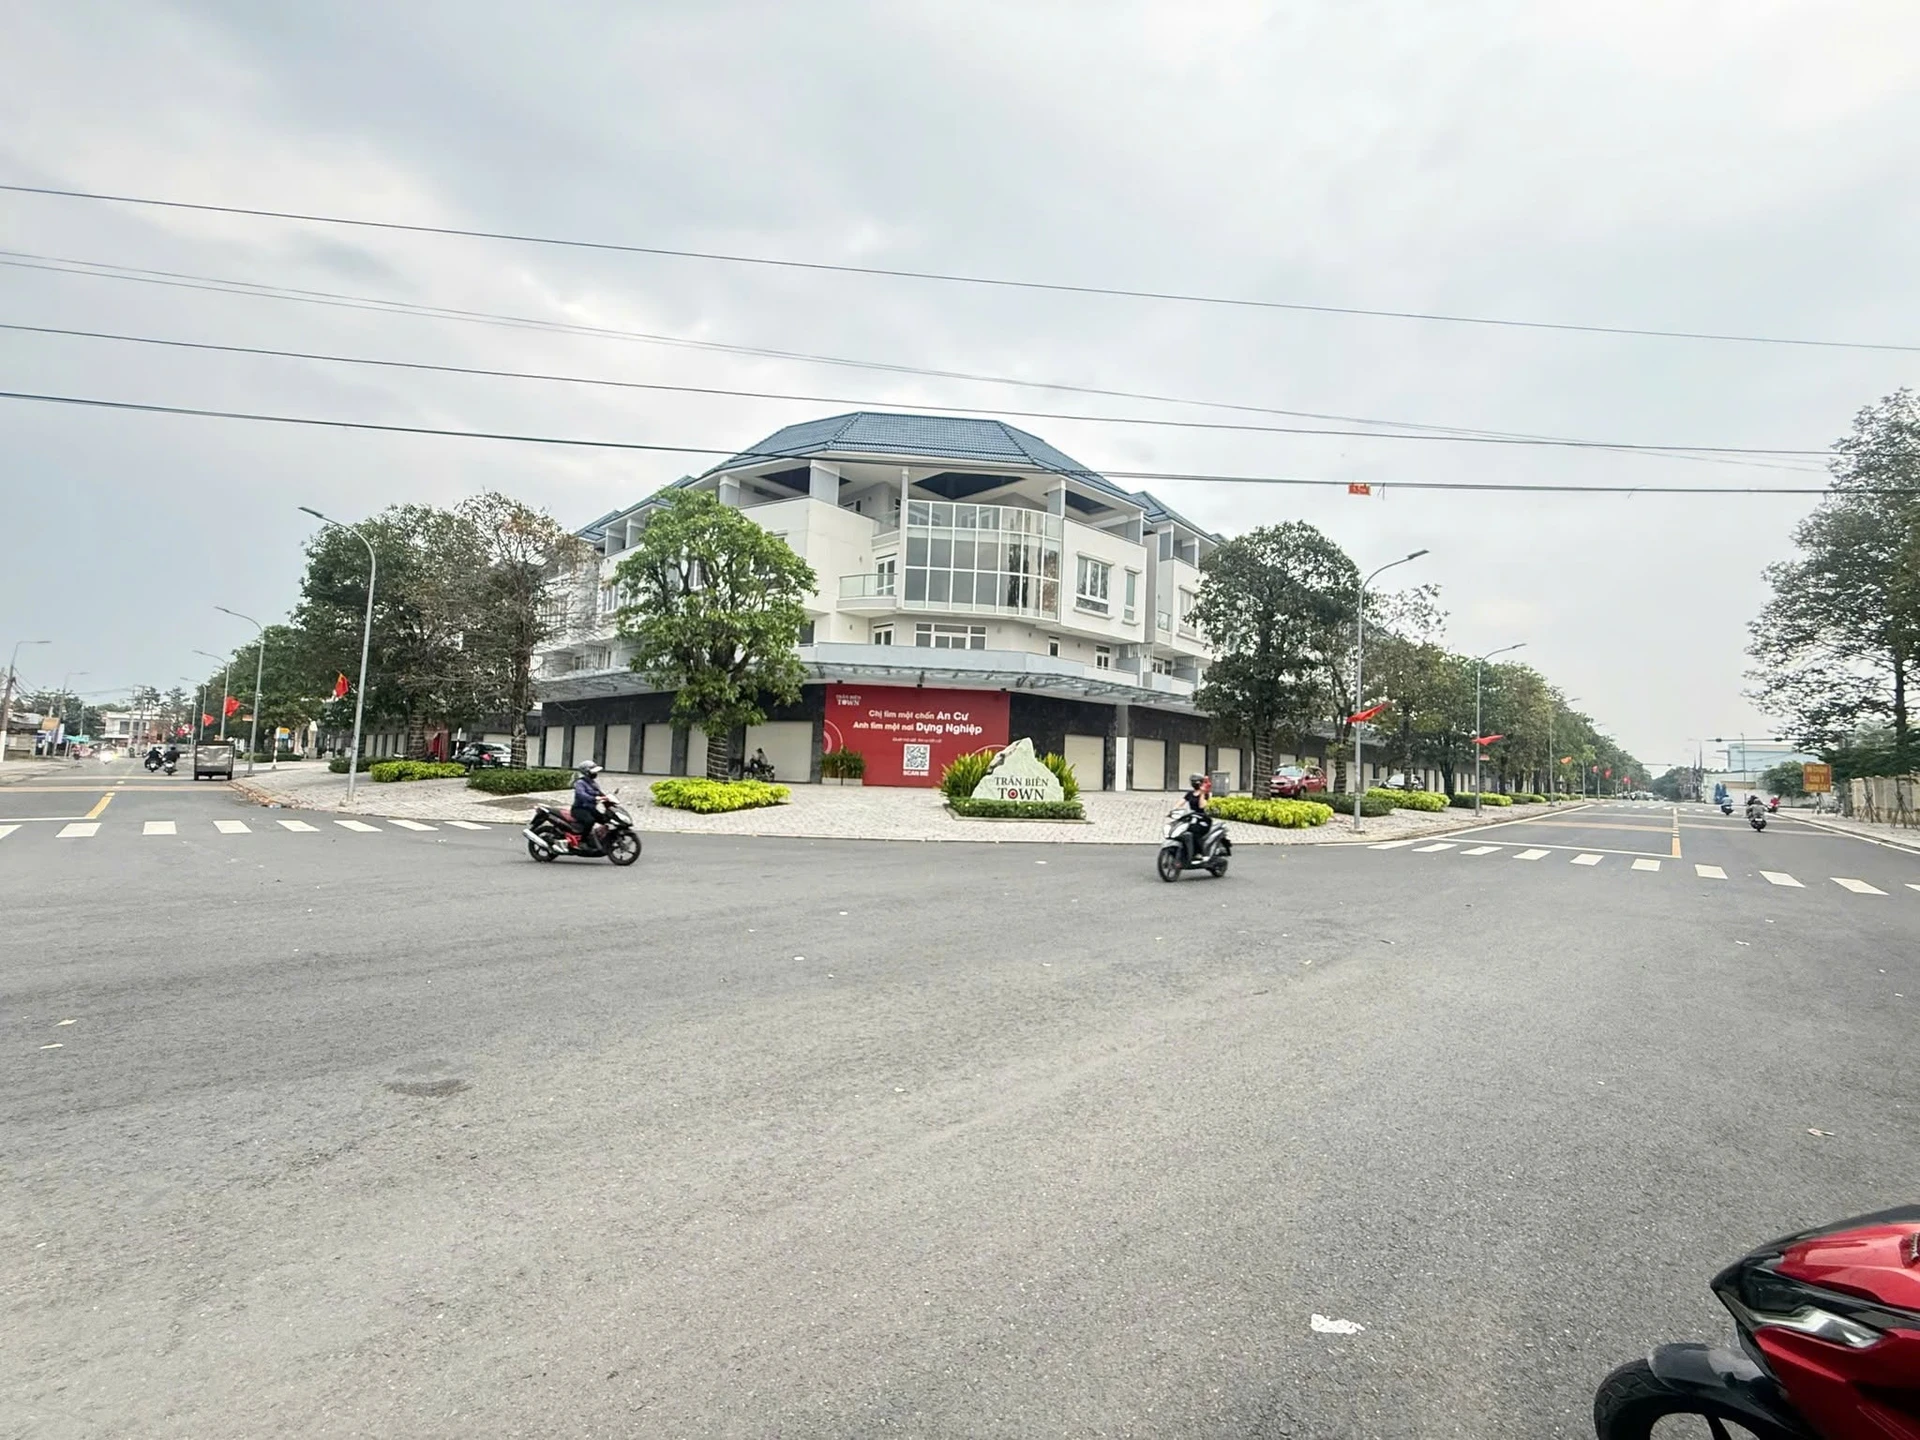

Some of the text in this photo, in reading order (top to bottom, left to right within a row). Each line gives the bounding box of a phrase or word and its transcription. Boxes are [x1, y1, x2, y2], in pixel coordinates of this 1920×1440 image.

[936, 711, 951, 720] An
[953, 711, 969, 721] Cư
[853, 721, 869, 729] Anh
[916, 722, 943, 734] Dựng
[946, 723, 983, 735] Nghiệp
[1025, 776, 1049, 787] BIÊN
[997, 787, 1045, 800] TOWN
